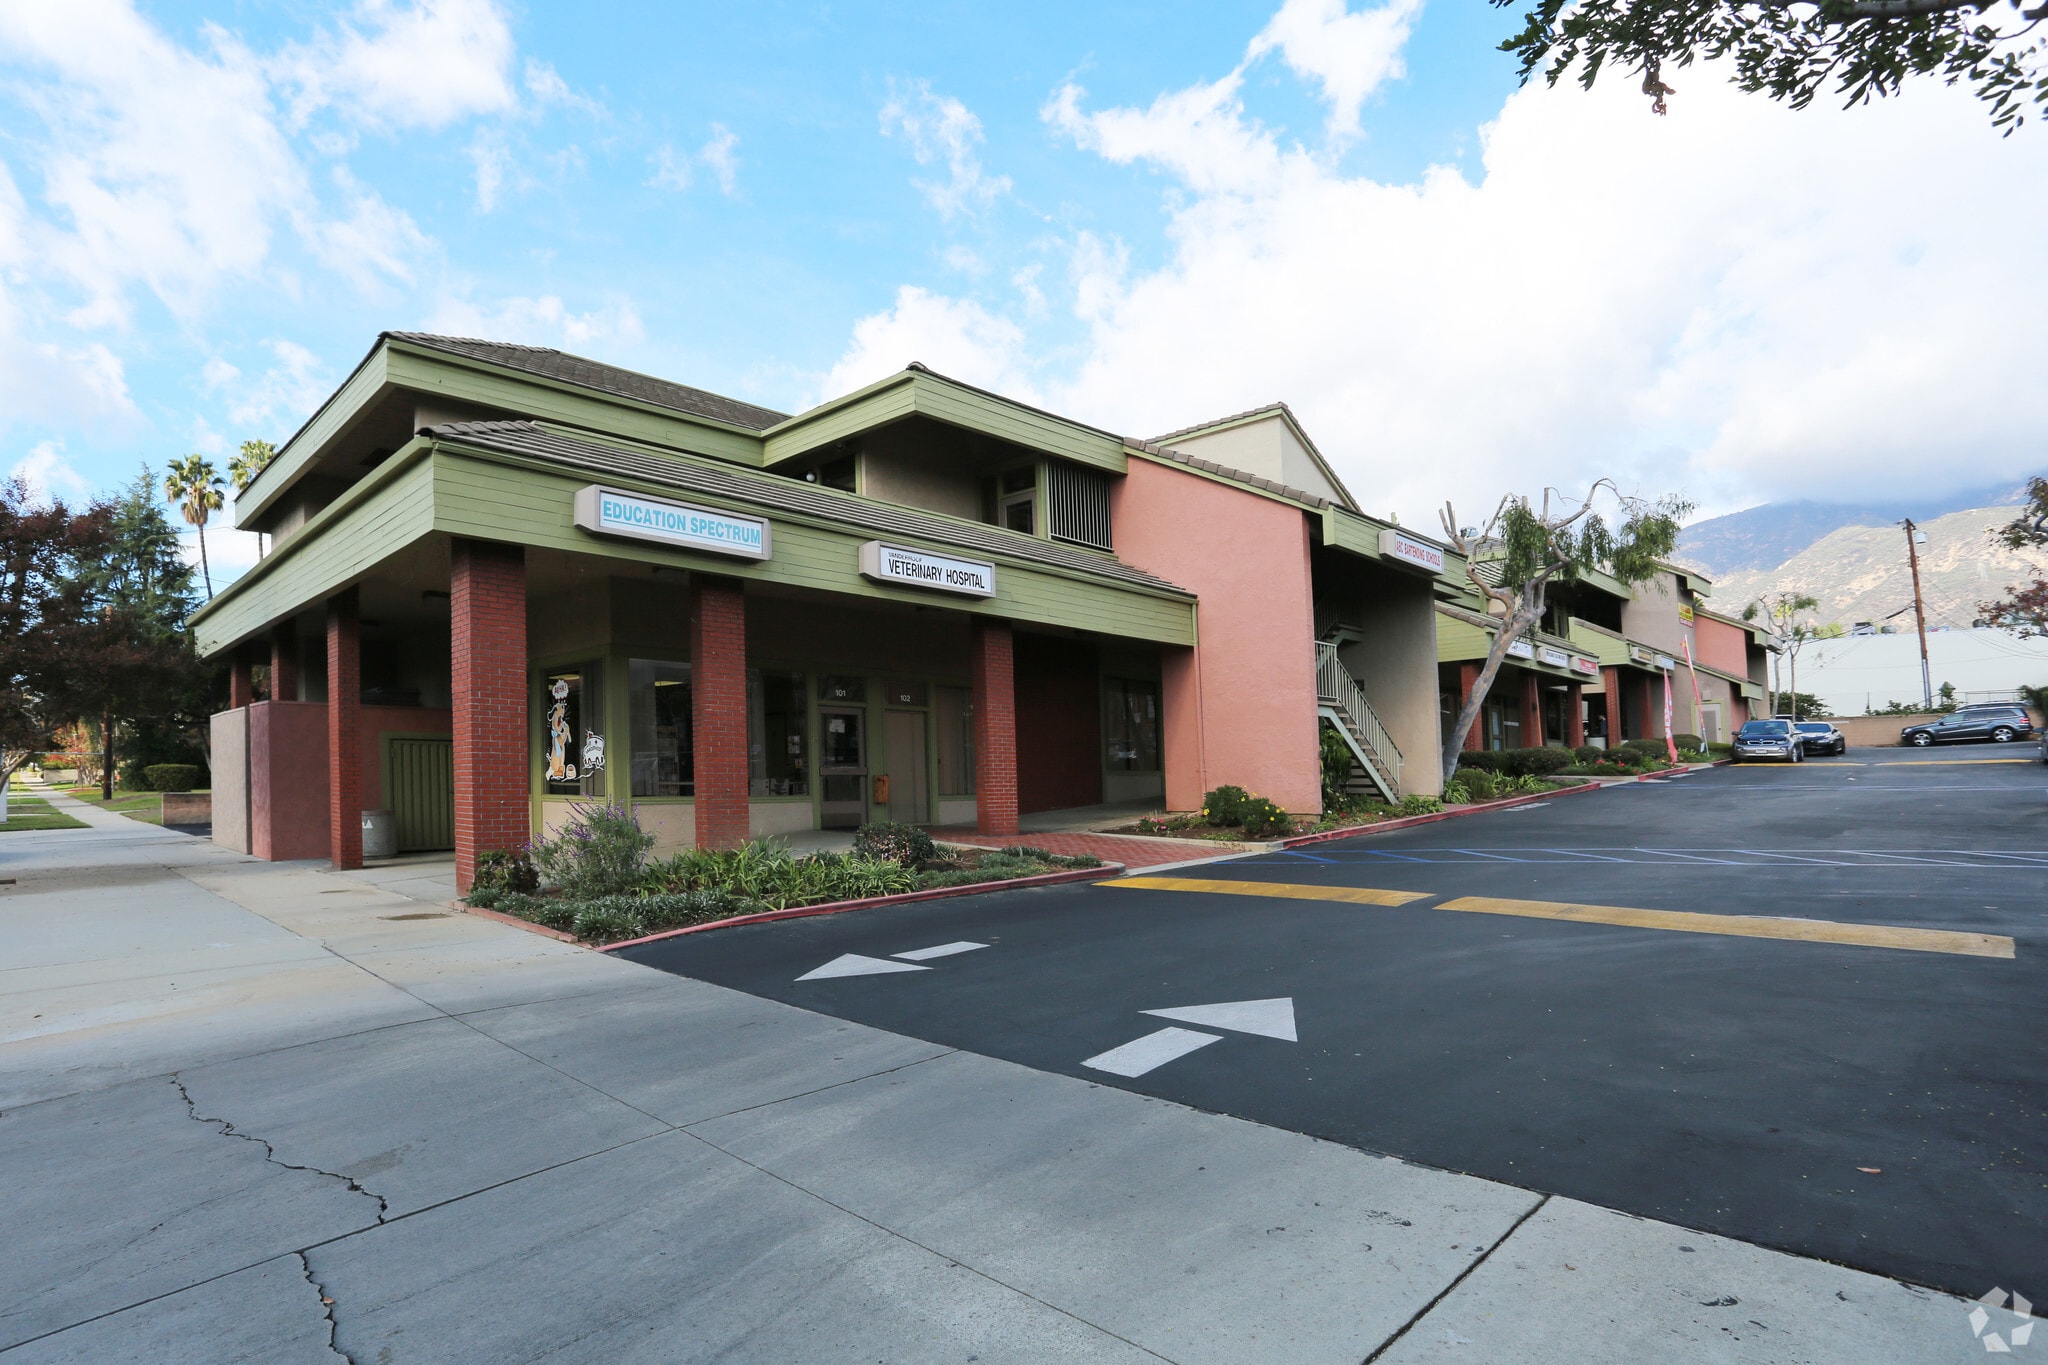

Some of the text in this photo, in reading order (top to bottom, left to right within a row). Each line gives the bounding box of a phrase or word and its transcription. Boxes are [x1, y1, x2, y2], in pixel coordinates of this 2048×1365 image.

[603, 500, 761, 544] EDUCATION SPECTRUM
[888, 558, 985, 589] VETERINARY HOSPITAL
[835, 689, 847, 697] 101
[899, 694, 911, 702] 102
